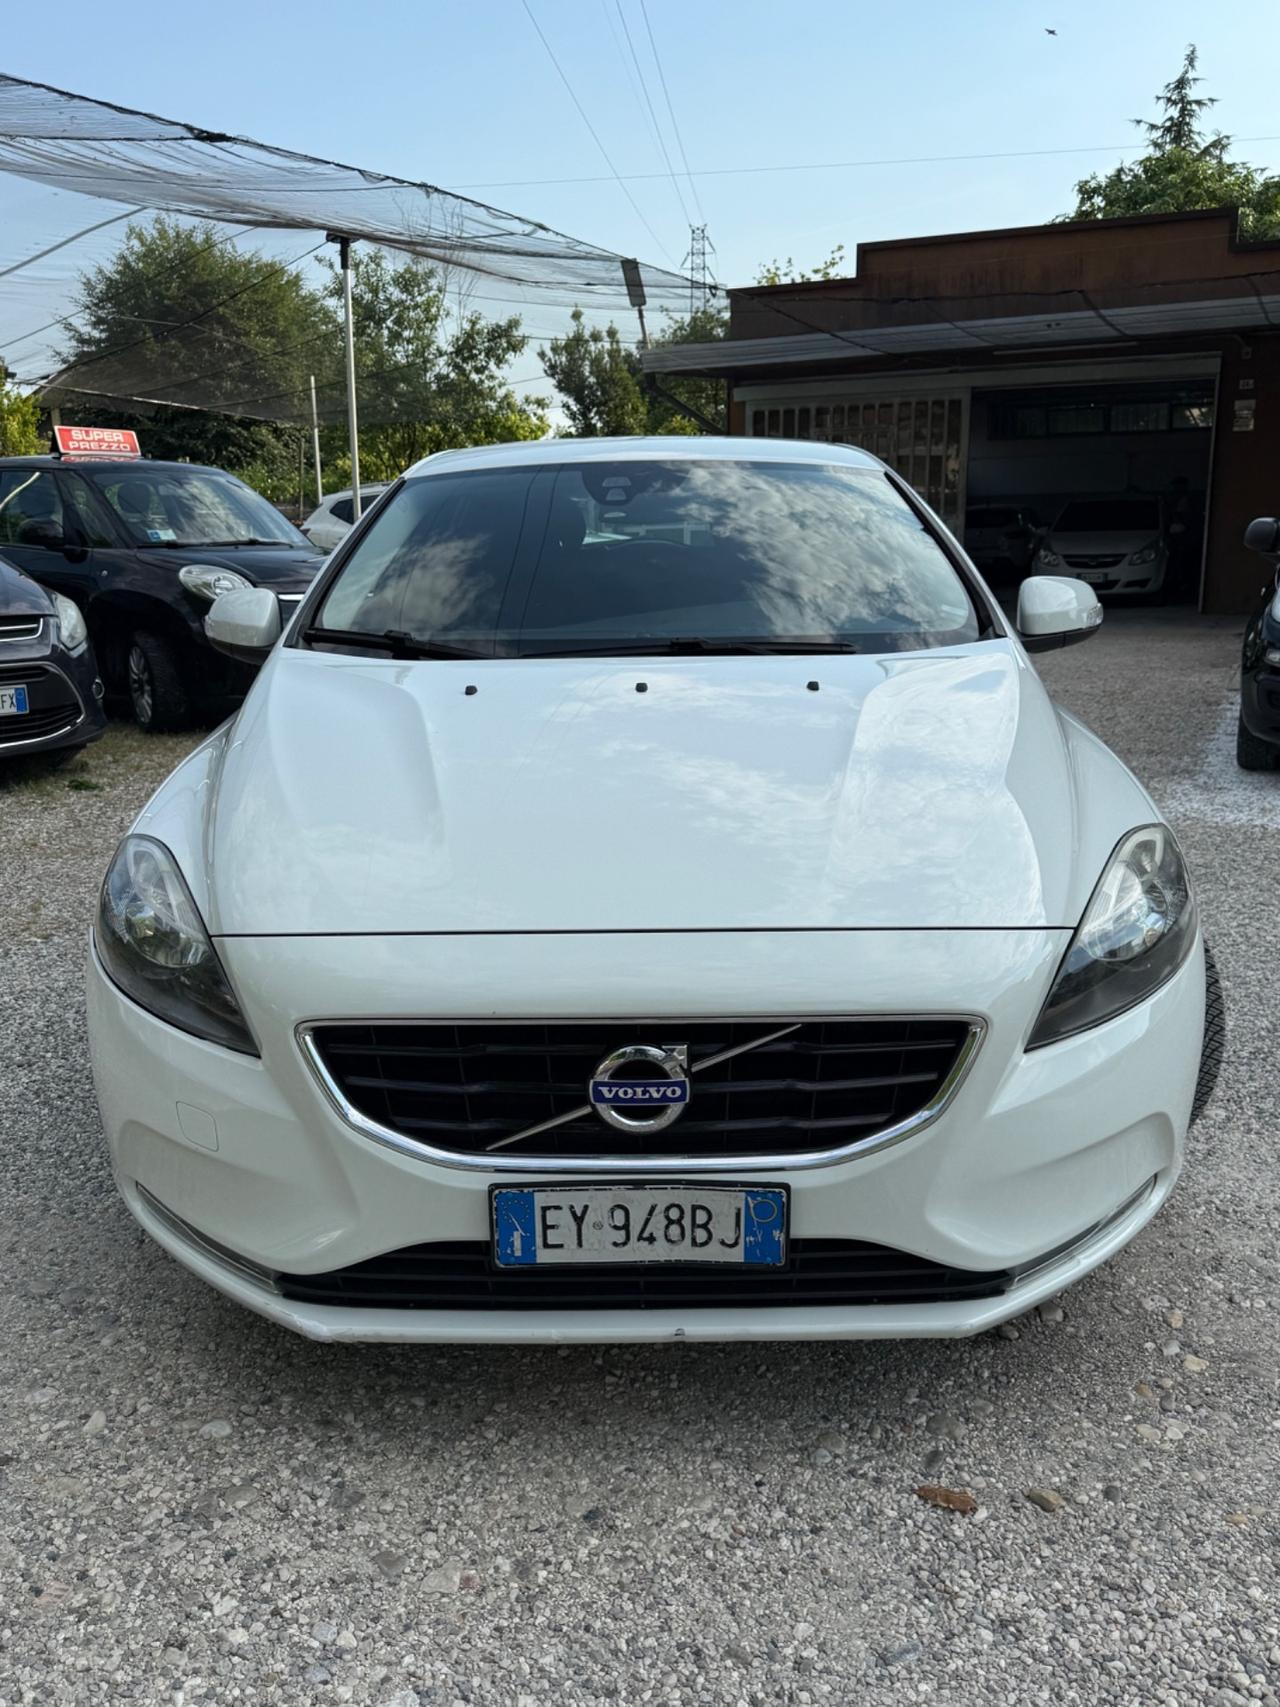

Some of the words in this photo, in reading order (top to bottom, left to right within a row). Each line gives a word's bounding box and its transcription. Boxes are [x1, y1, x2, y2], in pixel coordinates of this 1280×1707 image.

[71, 429, 124, 442] SUPER
[68, 441, 131, 451] PREZZO
[597, 1086, 682, 1099] VOLVO
